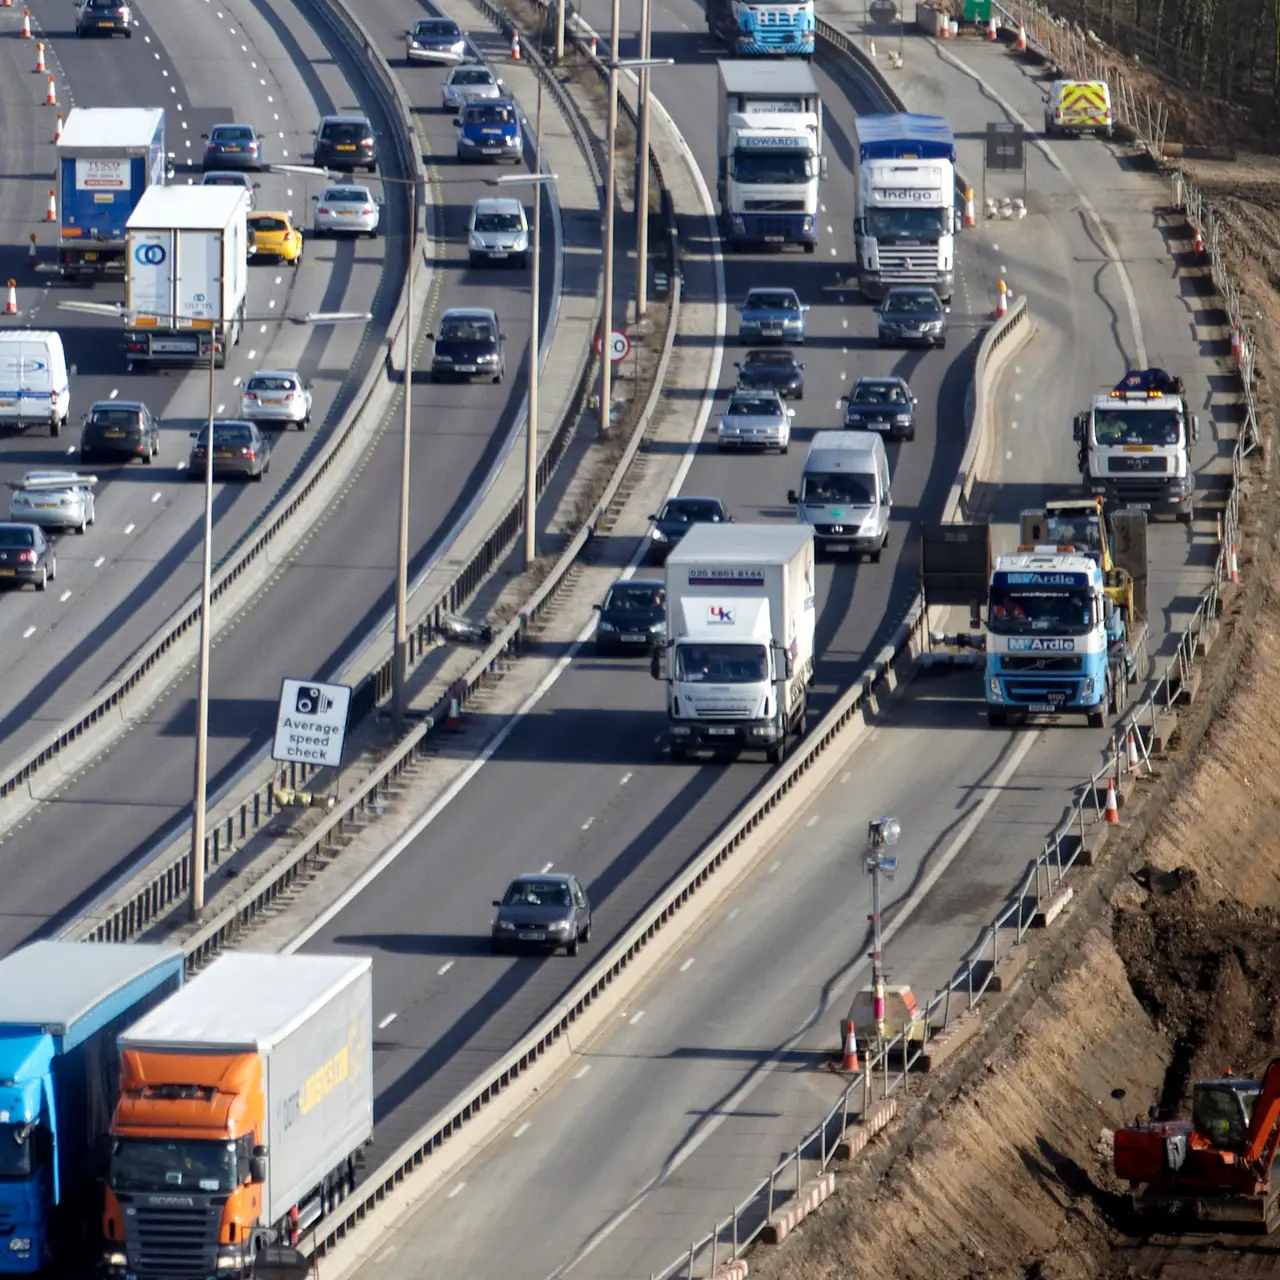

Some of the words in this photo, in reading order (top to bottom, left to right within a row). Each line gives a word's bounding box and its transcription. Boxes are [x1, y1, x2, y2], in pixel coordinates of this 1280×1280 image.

[745, 137, 801, 147] EDWARDS
[882, 187, 932, 201] Indigo
[283, 717, 340, 735] Average
[289, 734, 330, 747] speed
[286, 746, 328, 760] check
